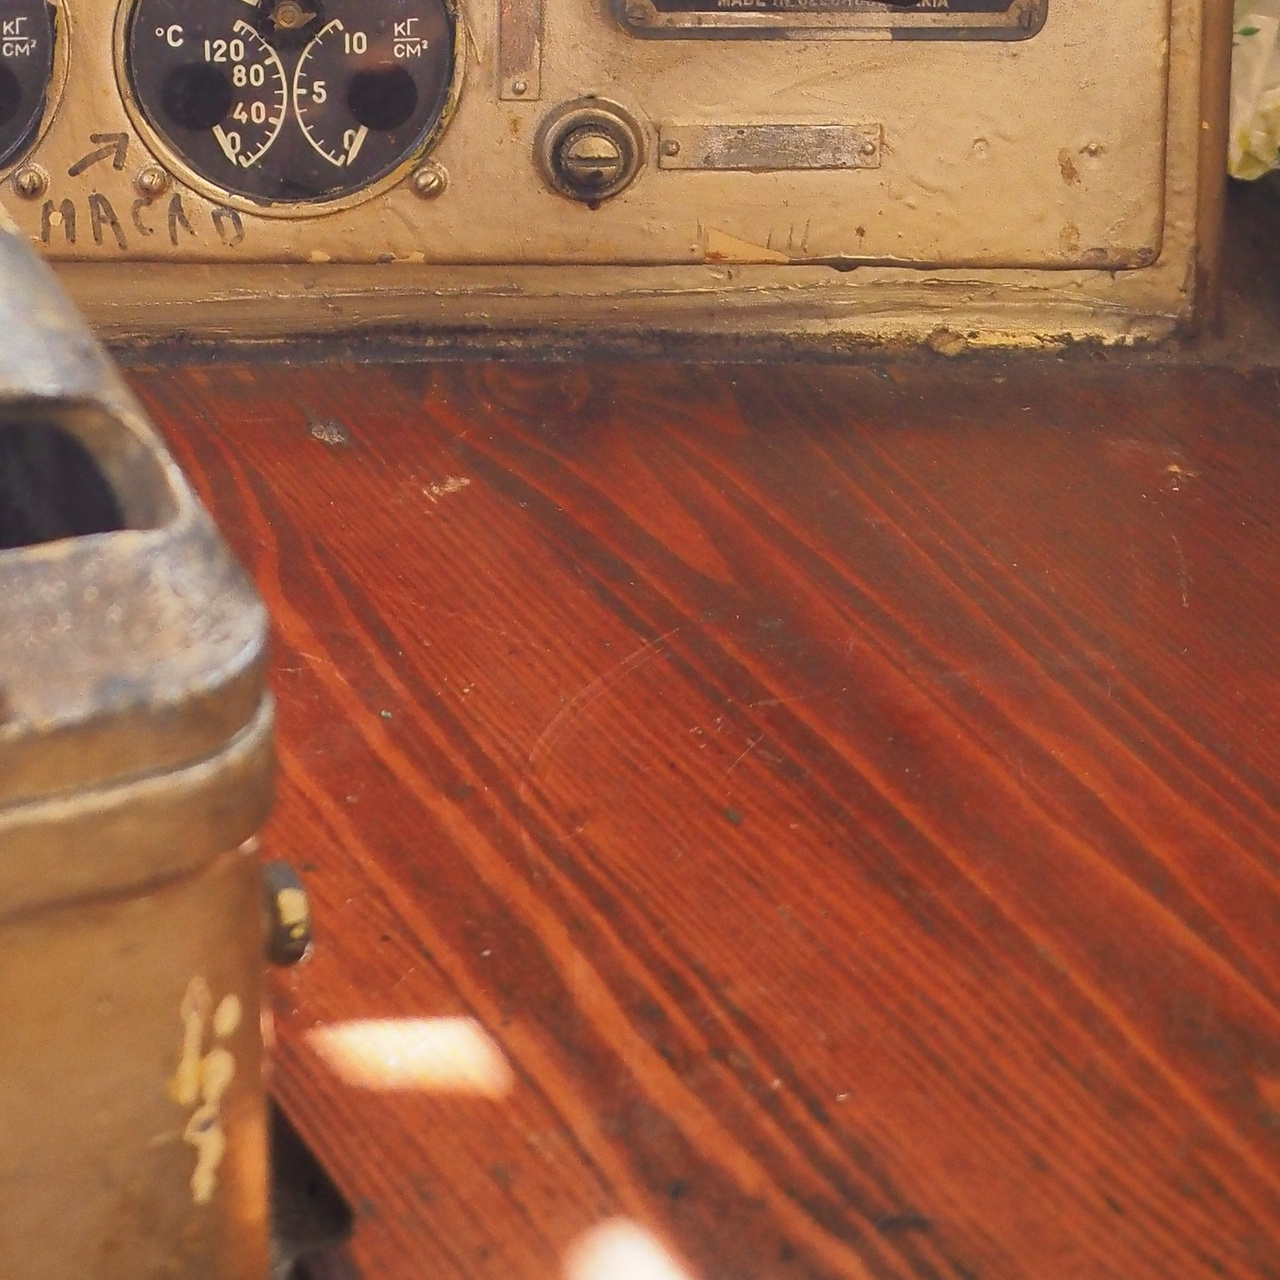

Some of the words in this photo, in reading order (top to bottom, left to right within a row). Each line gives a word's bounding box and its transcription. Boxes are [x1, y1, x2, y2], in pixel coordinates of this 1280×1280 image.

[204, 39, 244, 62] 120
[344, 32, 367, 54] 10
[233, 64, 264, 87] 80
[312, 80, 326, 103] 5
[233, 101, 265, 123] 40
